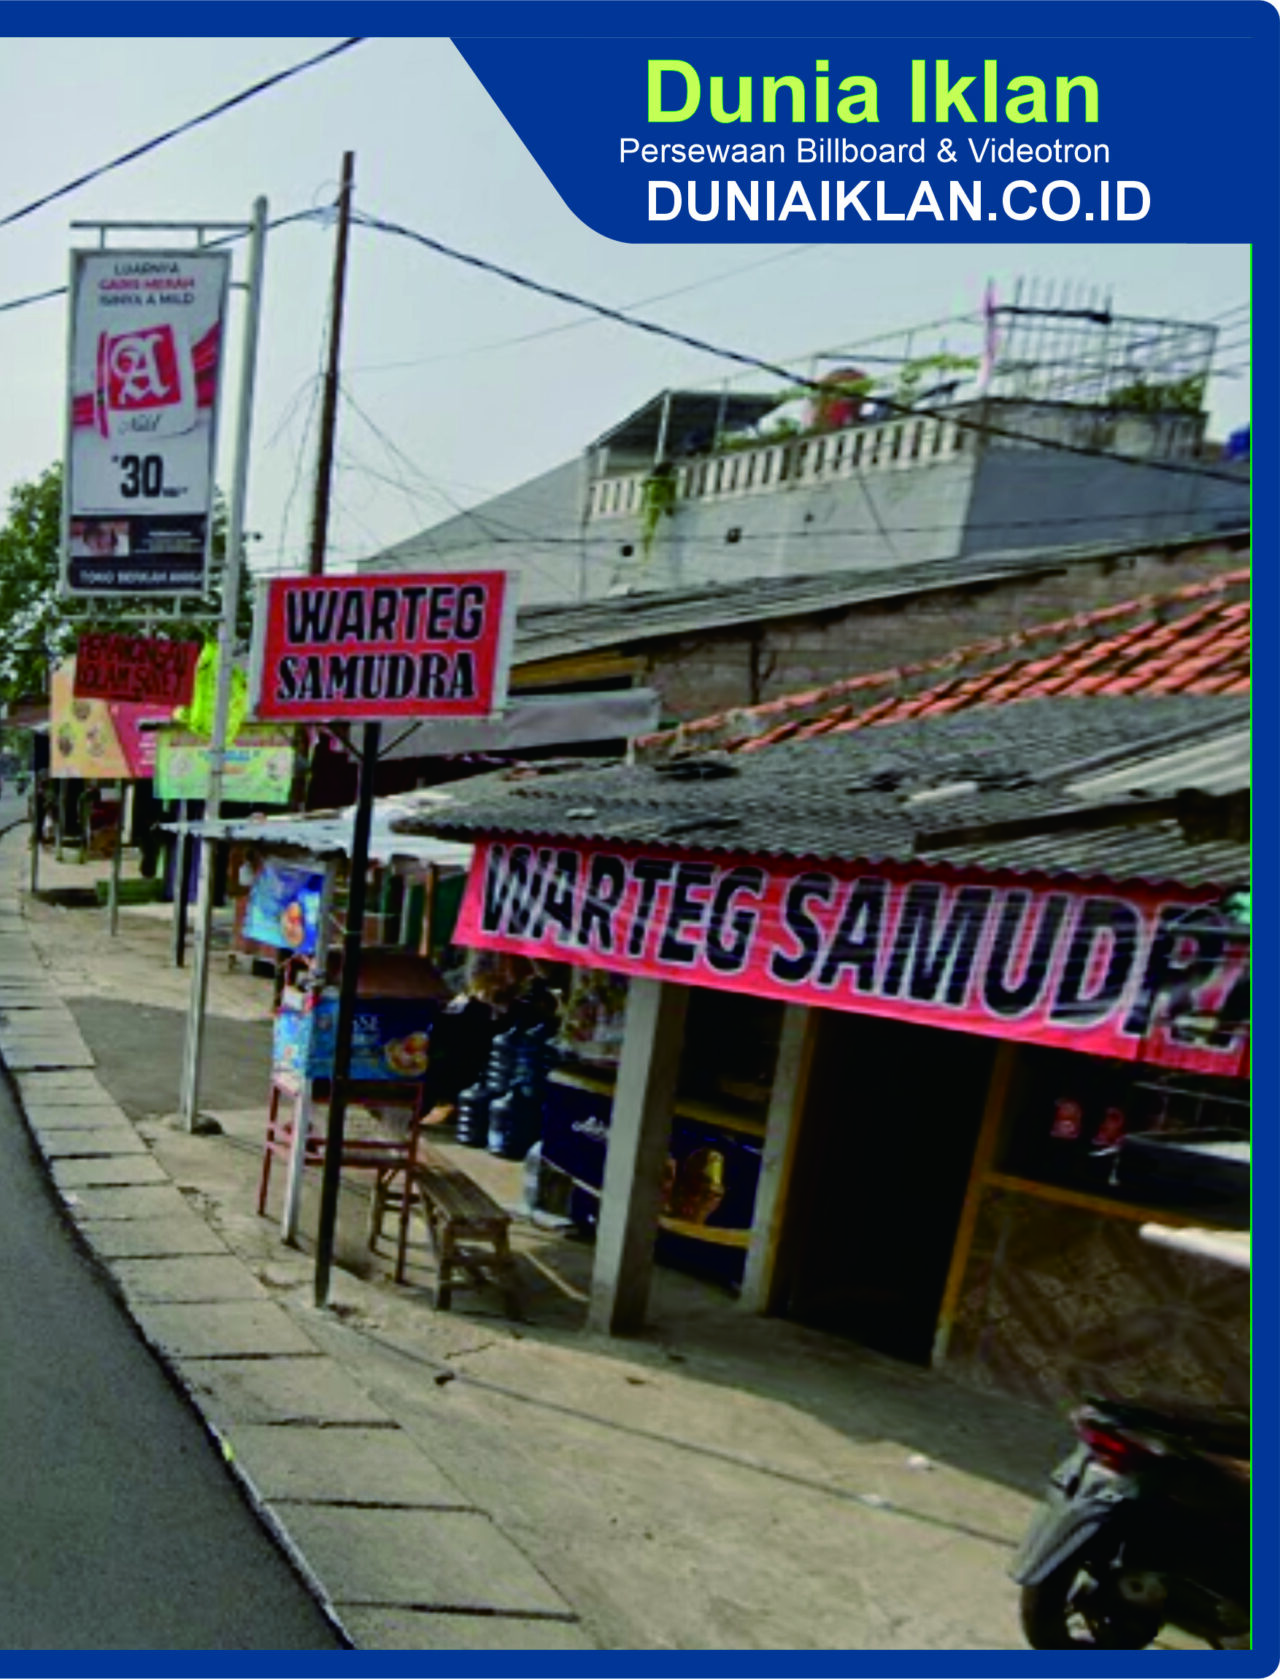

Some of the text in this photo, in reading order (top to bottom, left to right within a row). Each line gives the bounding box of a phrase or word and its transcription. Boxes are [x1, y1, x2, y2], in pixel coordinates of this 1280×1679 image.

[121, 455, 163, 498] 30
[286, 585, 485, 643] WARTEG
[277, 652, 476, 700] SAMUDRA
[481, 844, 765, 975] WARTEG
